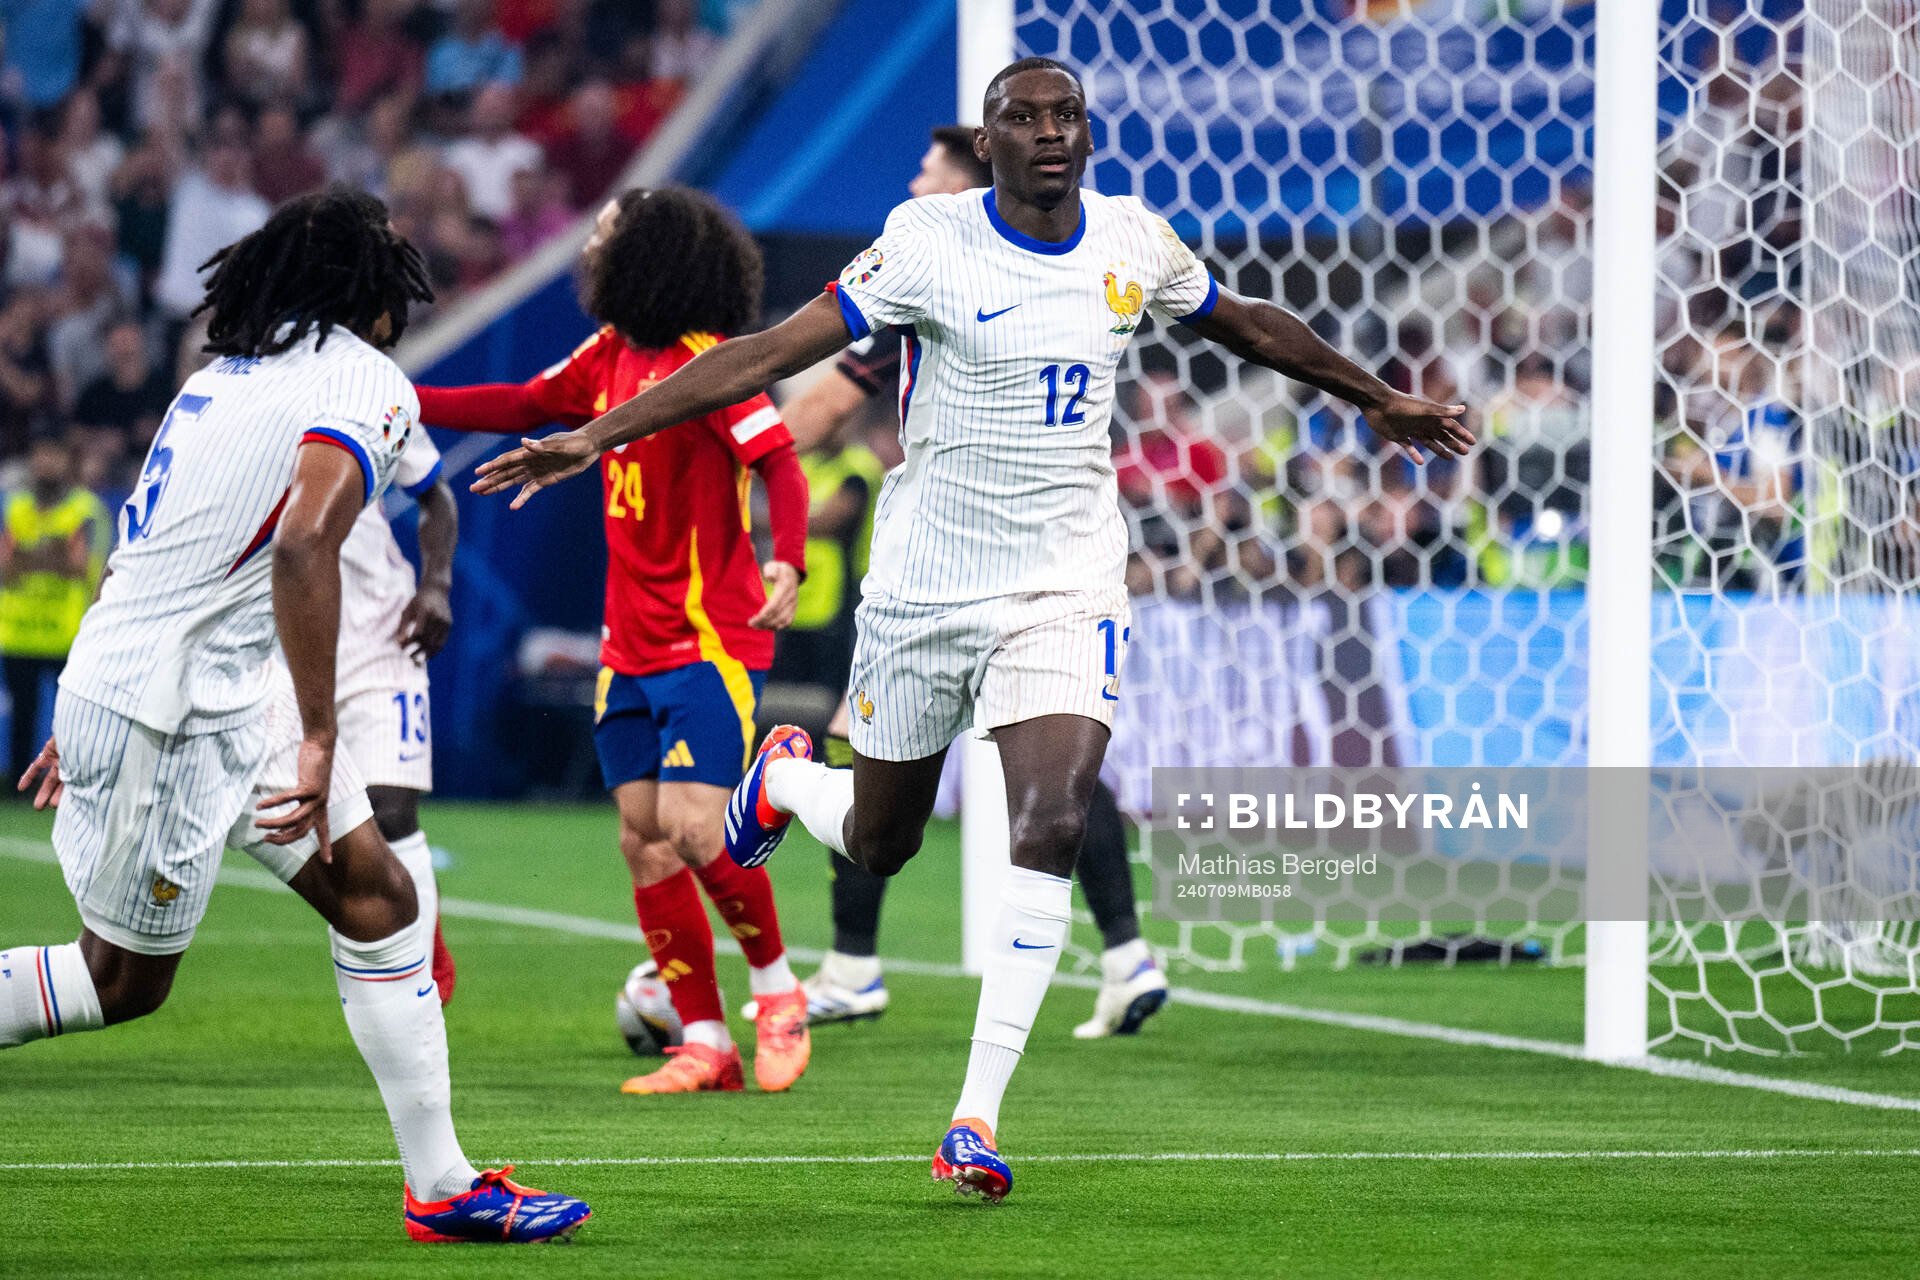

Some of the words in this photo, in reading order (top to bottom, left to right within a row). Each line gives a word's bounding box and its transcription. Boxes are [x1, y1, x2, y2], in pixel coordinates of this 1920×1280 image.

[1039, 363, 1090, 427] 12
[126, 394, 213, 544] 5
[608, 459, 646, 521] 24
[1098, 619, 1130, 678] 1
[392, 691, 427, 744] 13
